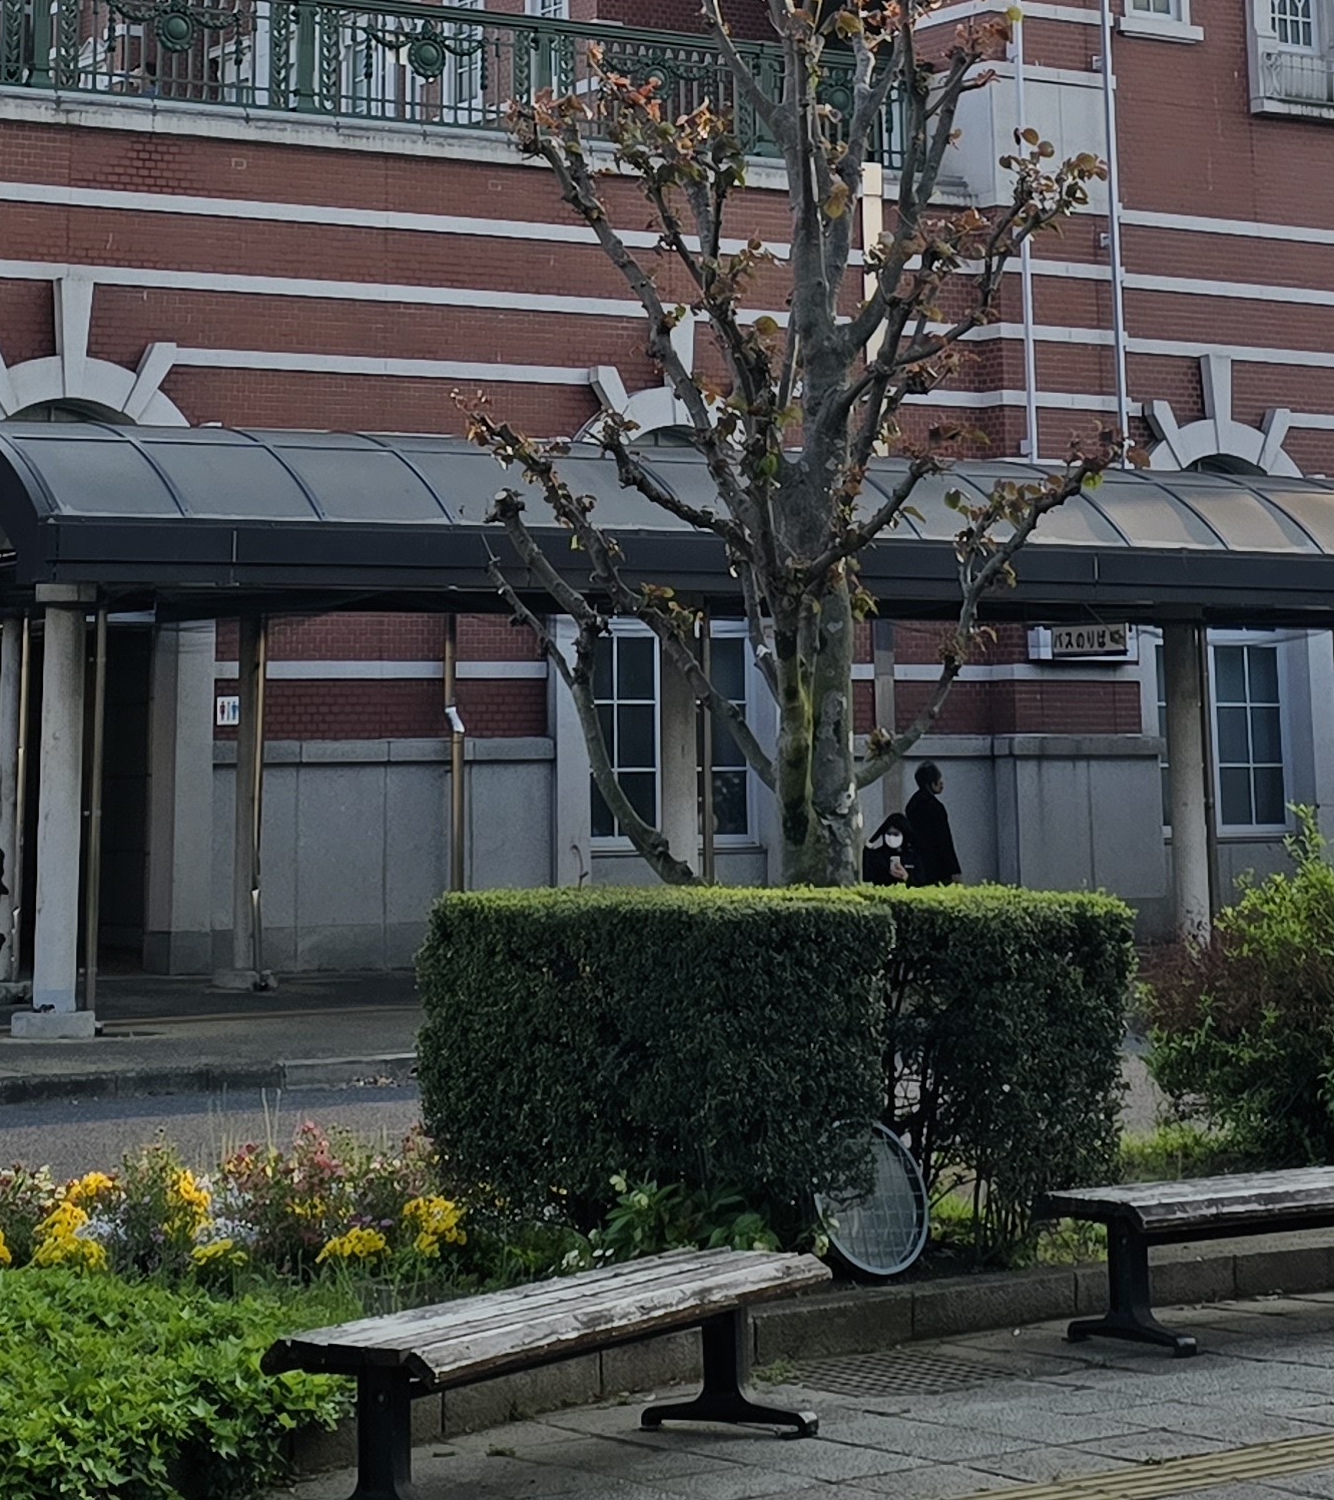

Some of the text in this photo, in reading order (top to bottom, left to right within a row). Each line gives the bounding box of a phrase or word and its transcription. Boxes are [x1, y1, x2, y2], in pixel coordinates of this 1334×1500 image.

[1053, 629, 1107, 649] バスのりば
